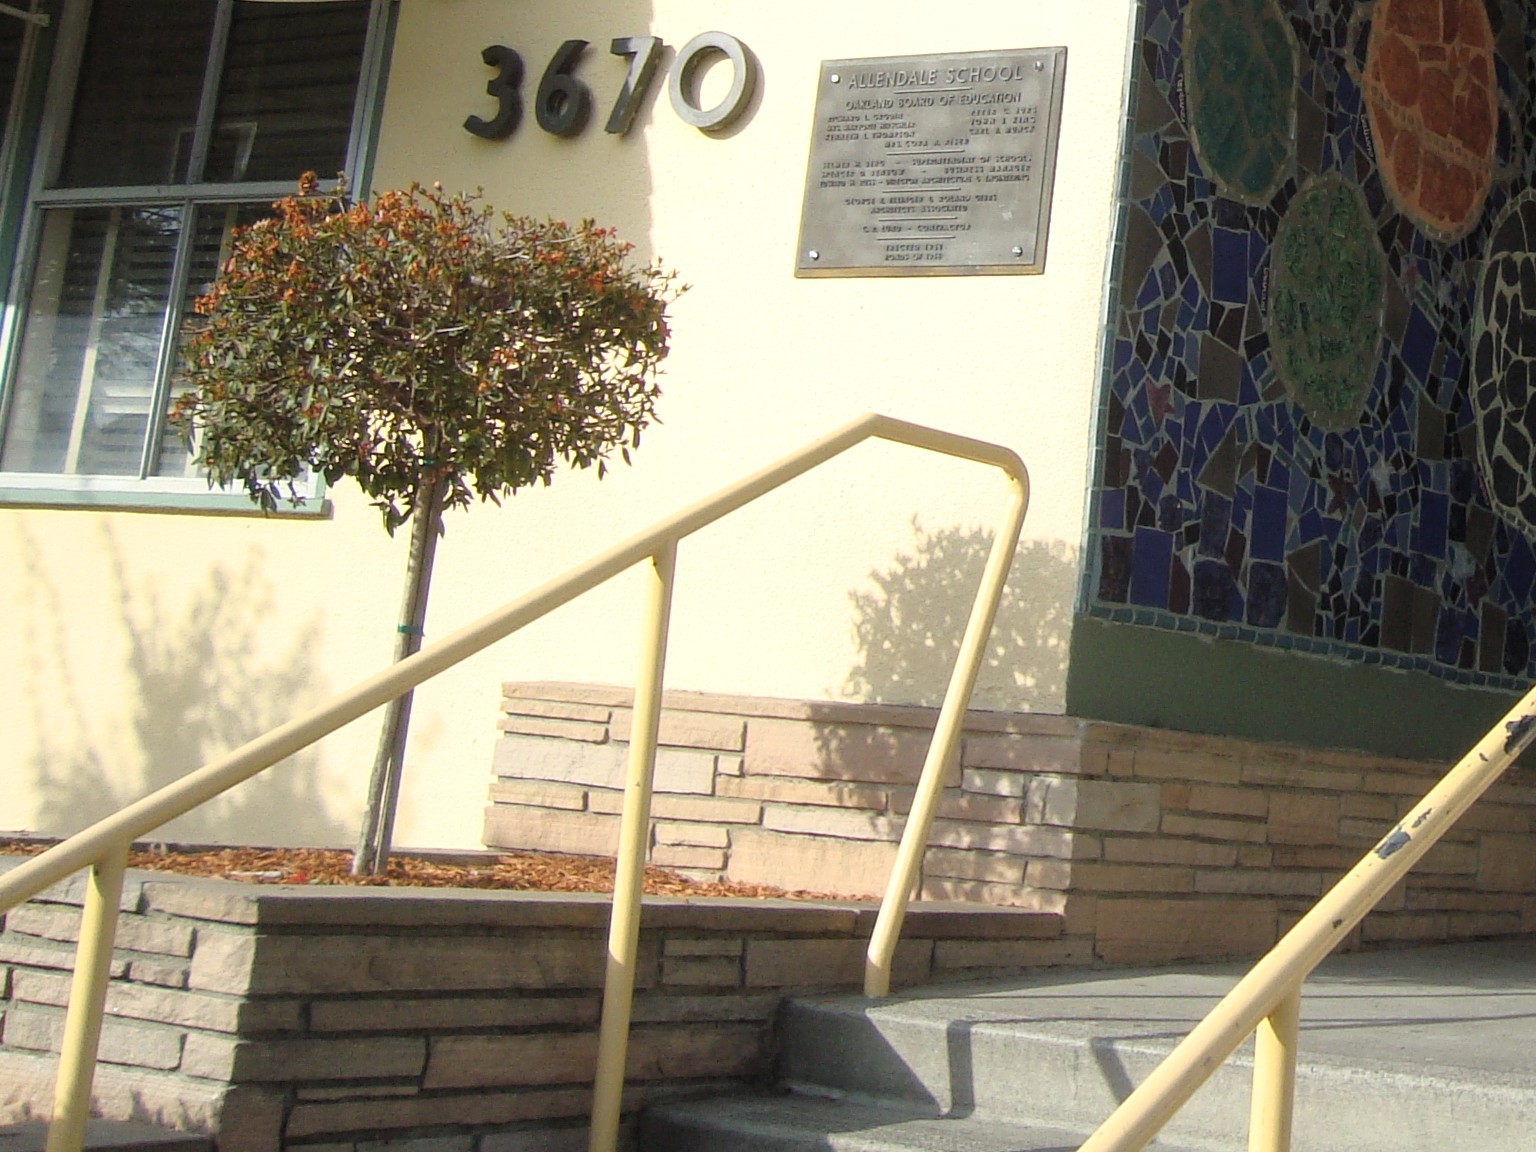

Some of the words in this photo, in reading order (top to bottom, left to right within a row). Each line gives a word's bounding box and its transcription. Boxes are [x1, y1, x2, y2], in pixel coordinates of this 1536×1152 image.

[462, 30, 760, 140] 3670
[847, 69, 938, 89] ALLENDALE
[945, 64, 1024, 84] SCHOOL
[845, 98, 893, 110] OAKLAND
[898, 96, 933, 108] BOARD
[939, 95, 954, 106] OF
[960, 92, 1021, 105] EDUCATION
